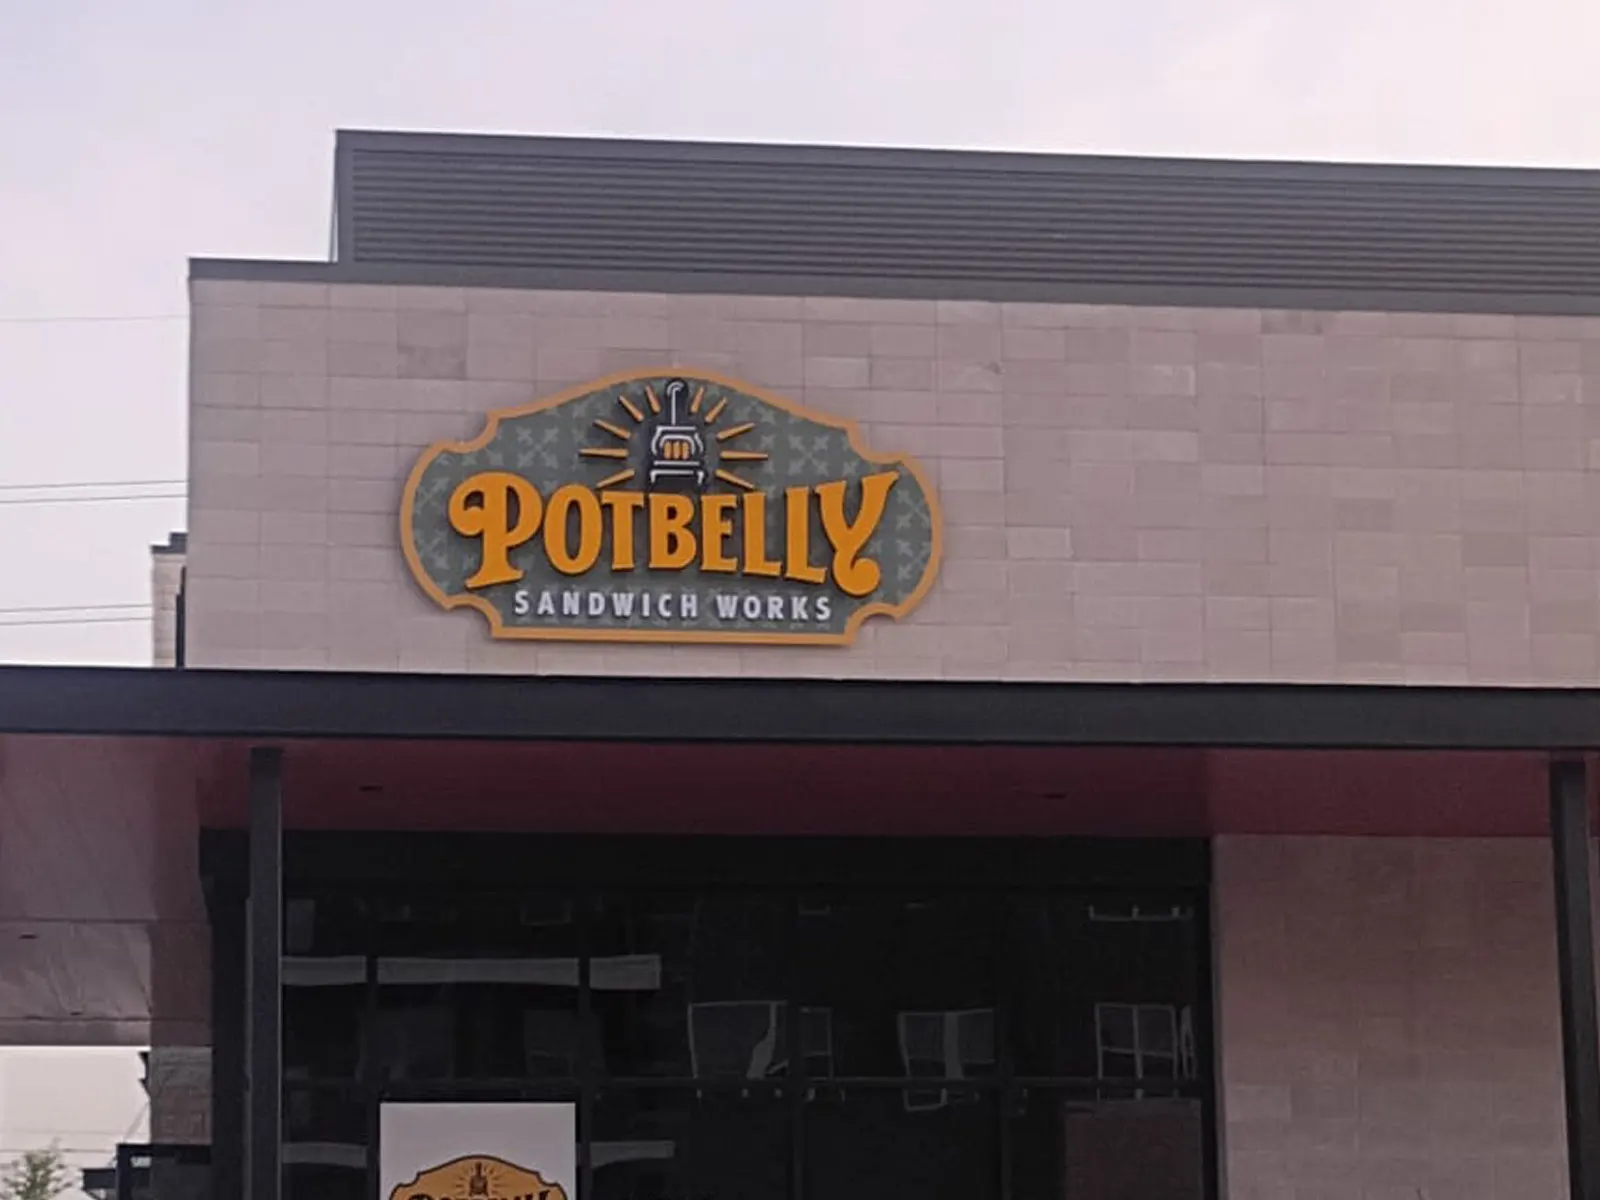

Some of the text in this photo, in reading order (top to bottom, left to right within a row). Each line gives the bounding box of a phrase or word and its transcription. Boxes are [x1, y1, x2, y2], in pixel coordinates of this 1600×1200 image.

[449, 472, 898, 595] POTBELLY
[513, 590, 833, 622] SANDWICH WORKS
